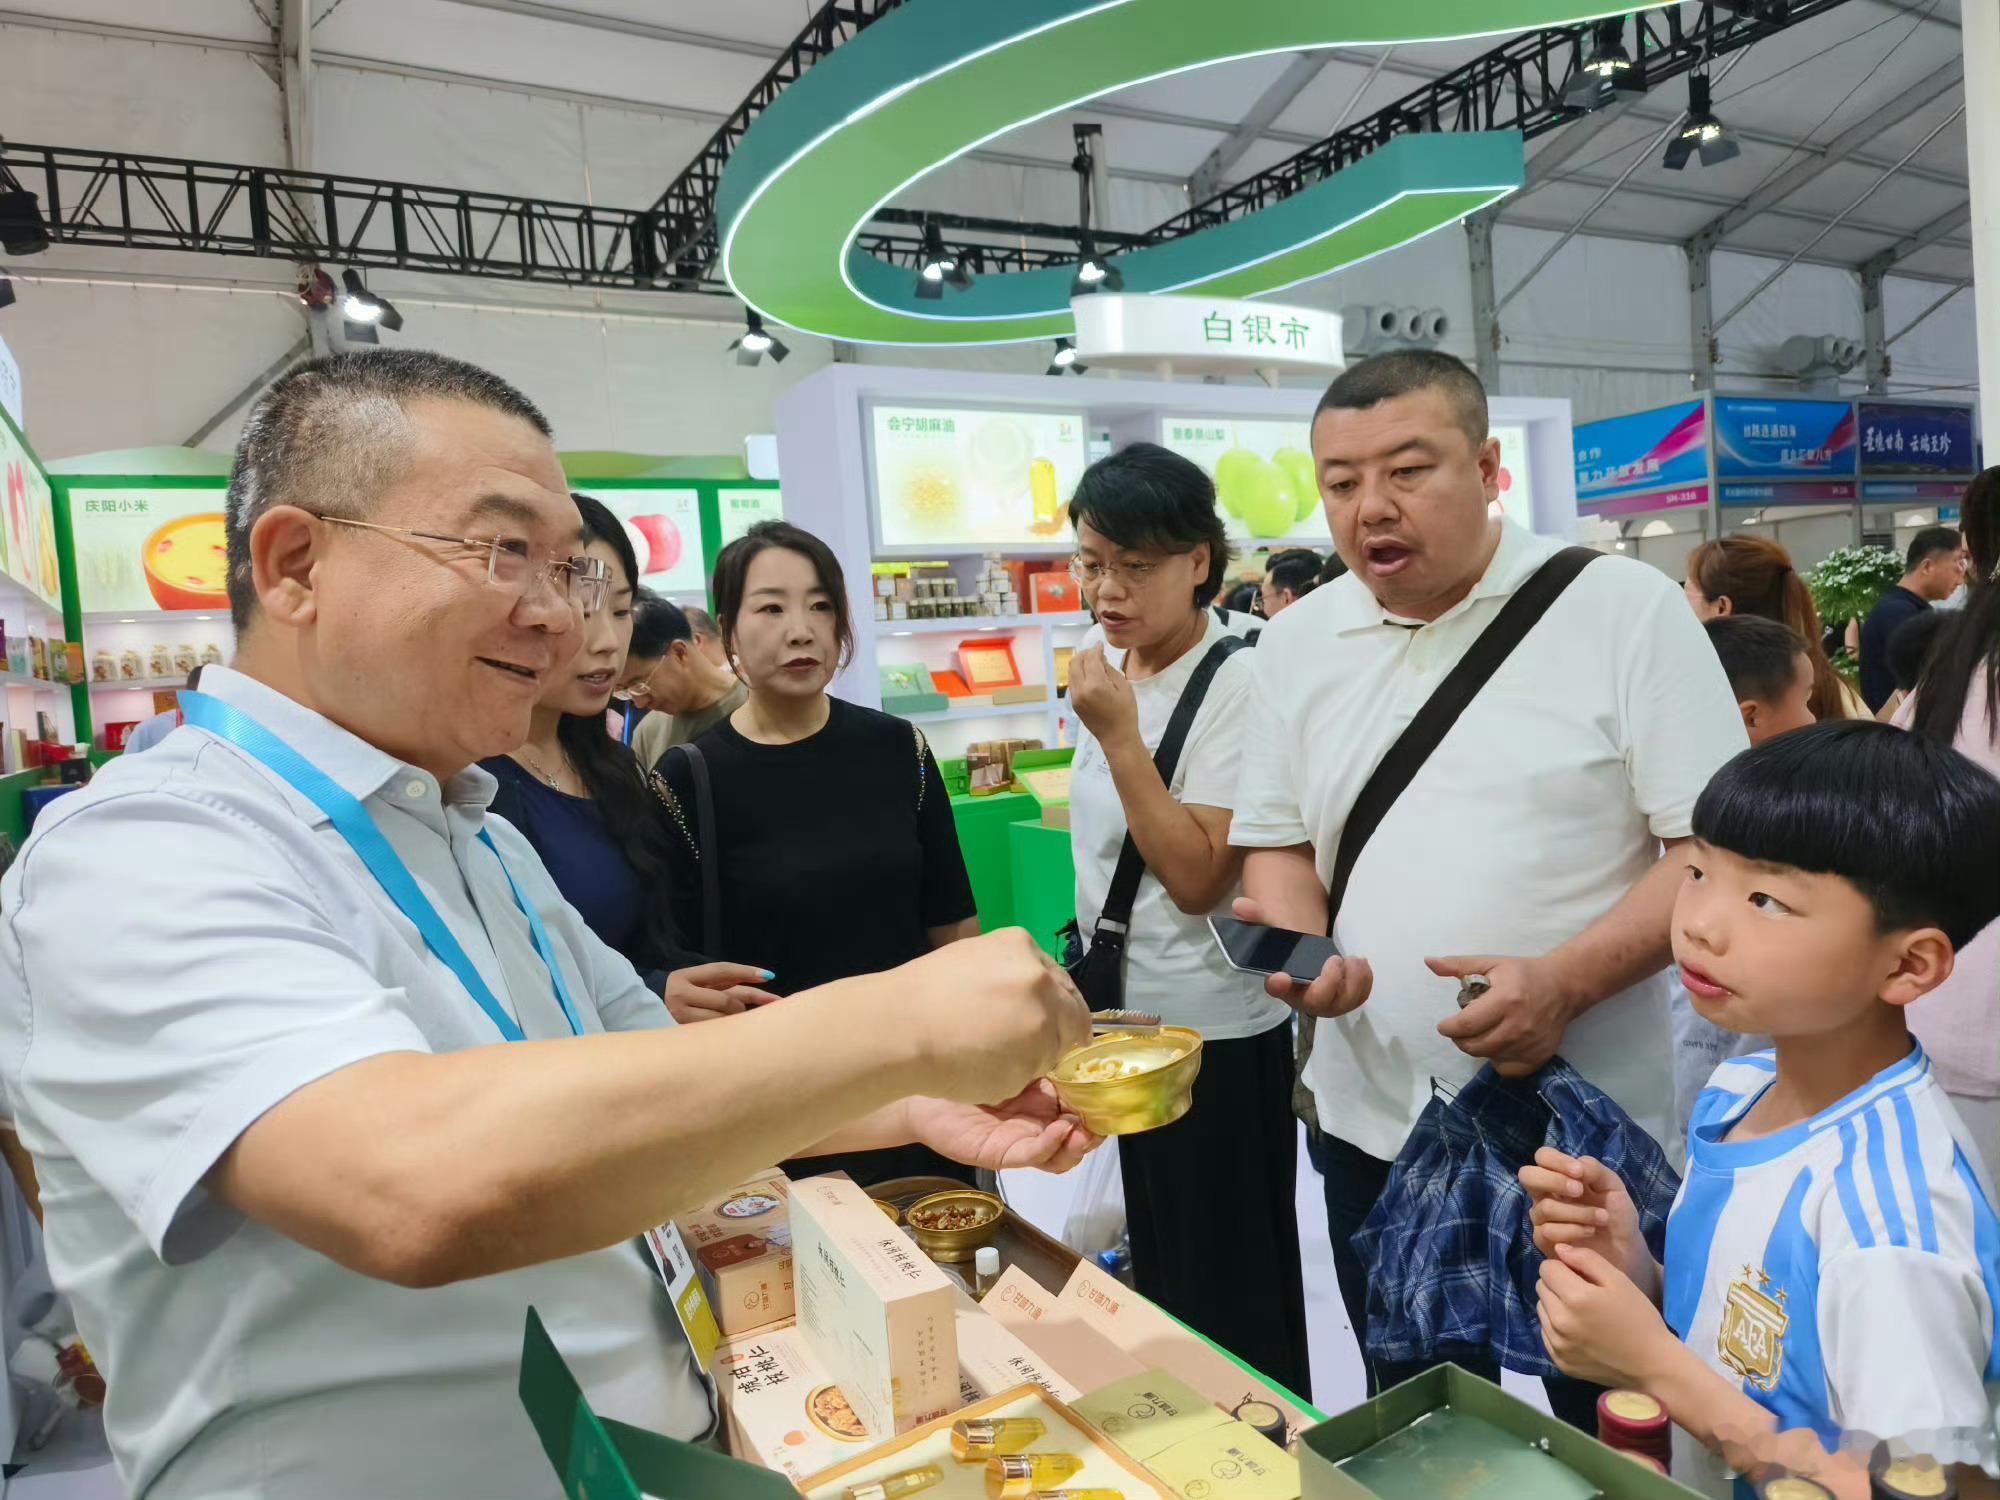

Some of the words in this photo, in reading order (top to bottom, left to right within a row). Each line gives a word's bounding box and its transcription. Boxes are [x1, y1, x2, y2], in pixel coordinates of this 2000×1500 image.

[1203, 311, 1310, 350] 白银市
[887, 415, 956, 433] 会宁胡麻油
[85, 499, 149, 512] 庆阳小米
[1733, 1309, 1769, 1360] AFA
[748, 1345, 791, 1386] 核桃仁
